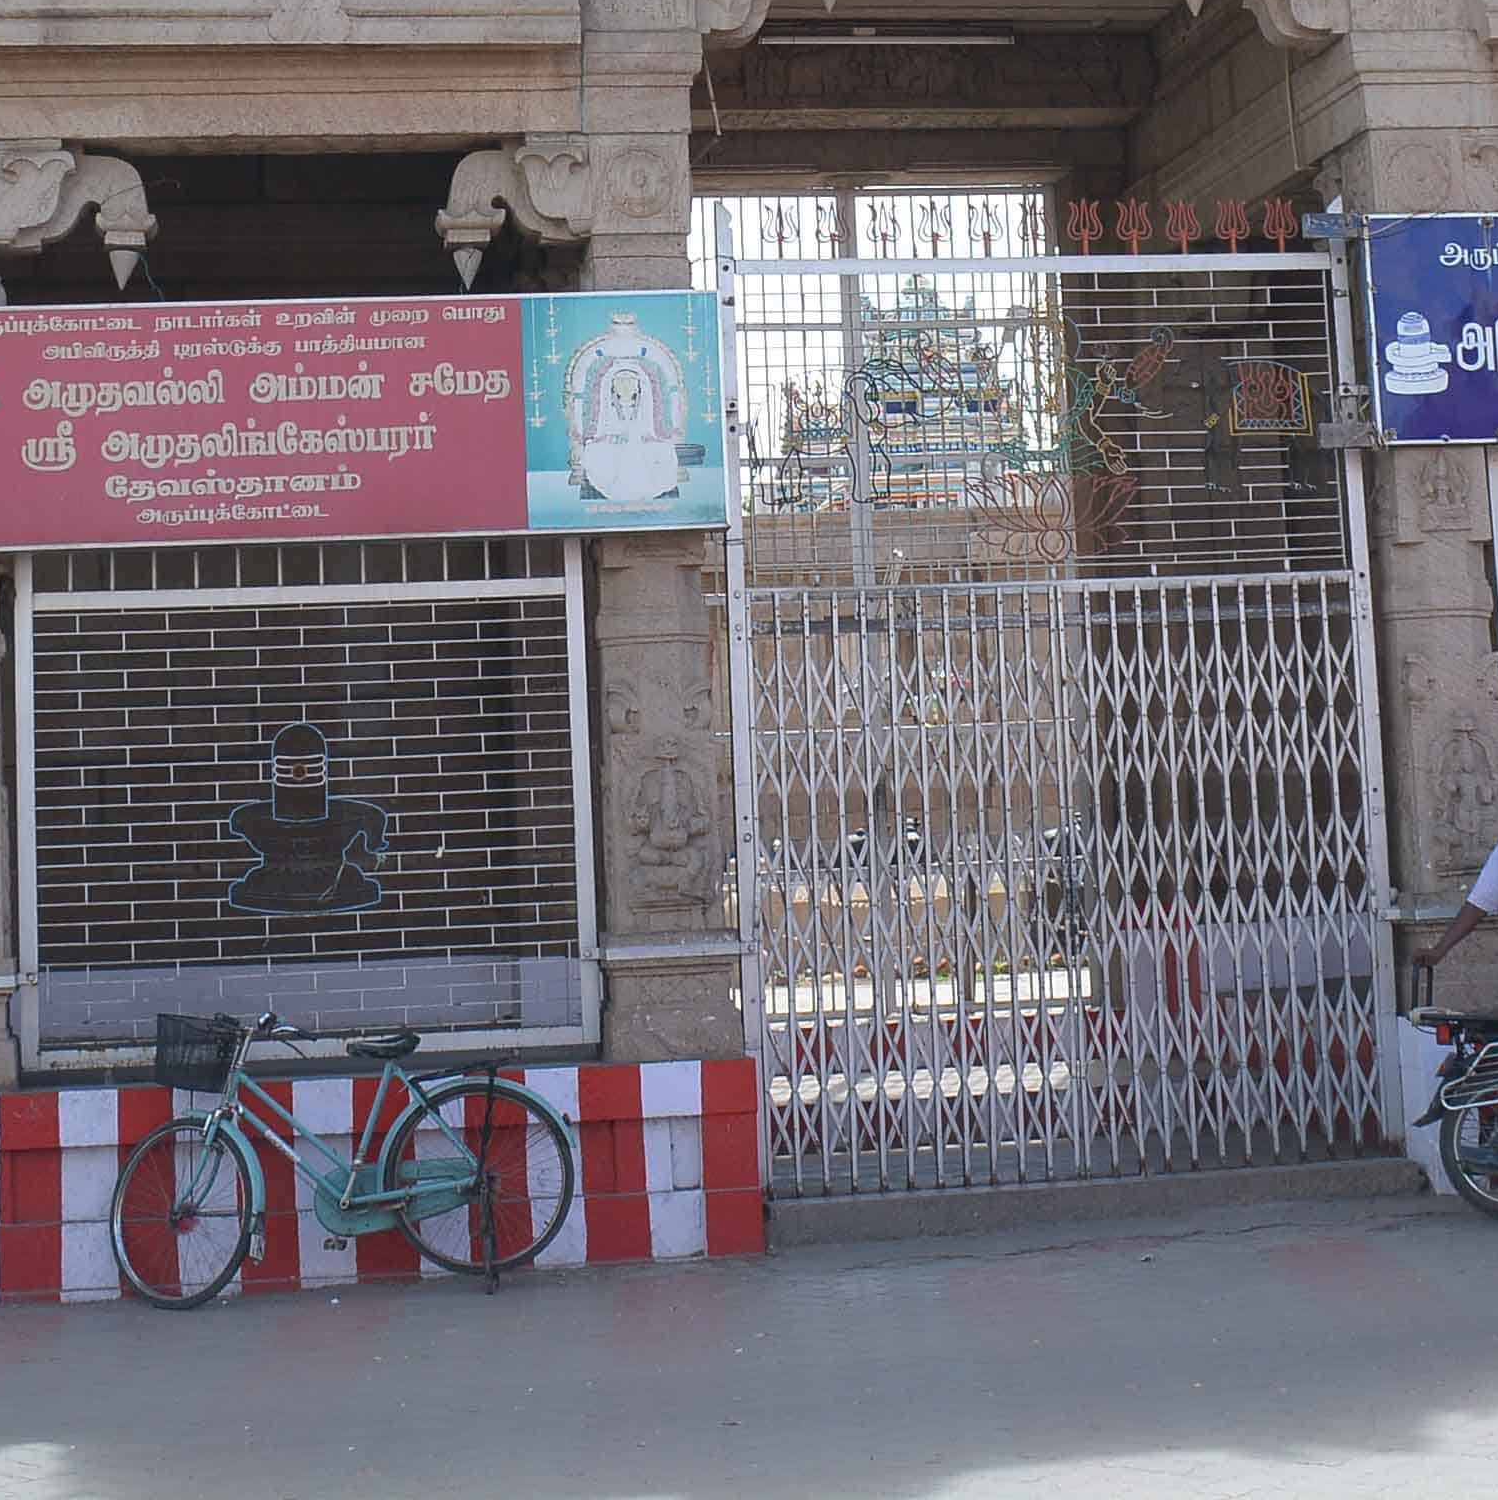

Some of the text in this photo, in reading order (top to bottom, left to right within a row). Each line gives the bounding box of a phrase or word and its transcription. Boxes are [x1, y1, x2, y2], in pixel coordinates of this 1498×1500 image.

[154, 309, 262, 332] நாடார்கள்
[276, 306, 357, 329] உறவின்
[369, 306, 429, 327] முறை
[442, 306, 505, 323] பொது
[42, 334, 427, 361] அபிவிருத்தி டிரஸ்டுக்கு பாத்தியமான
[22, 366, 226, 418] அமுதவல்லி
[250, 360, 385, 403] அம்மன்
[409, 362, 511, 404] சமேத
[105, 464, 361, 503] தேவஸ்தானம்
[136, 502, 329, 525] அருப்புக்கோட்டை
